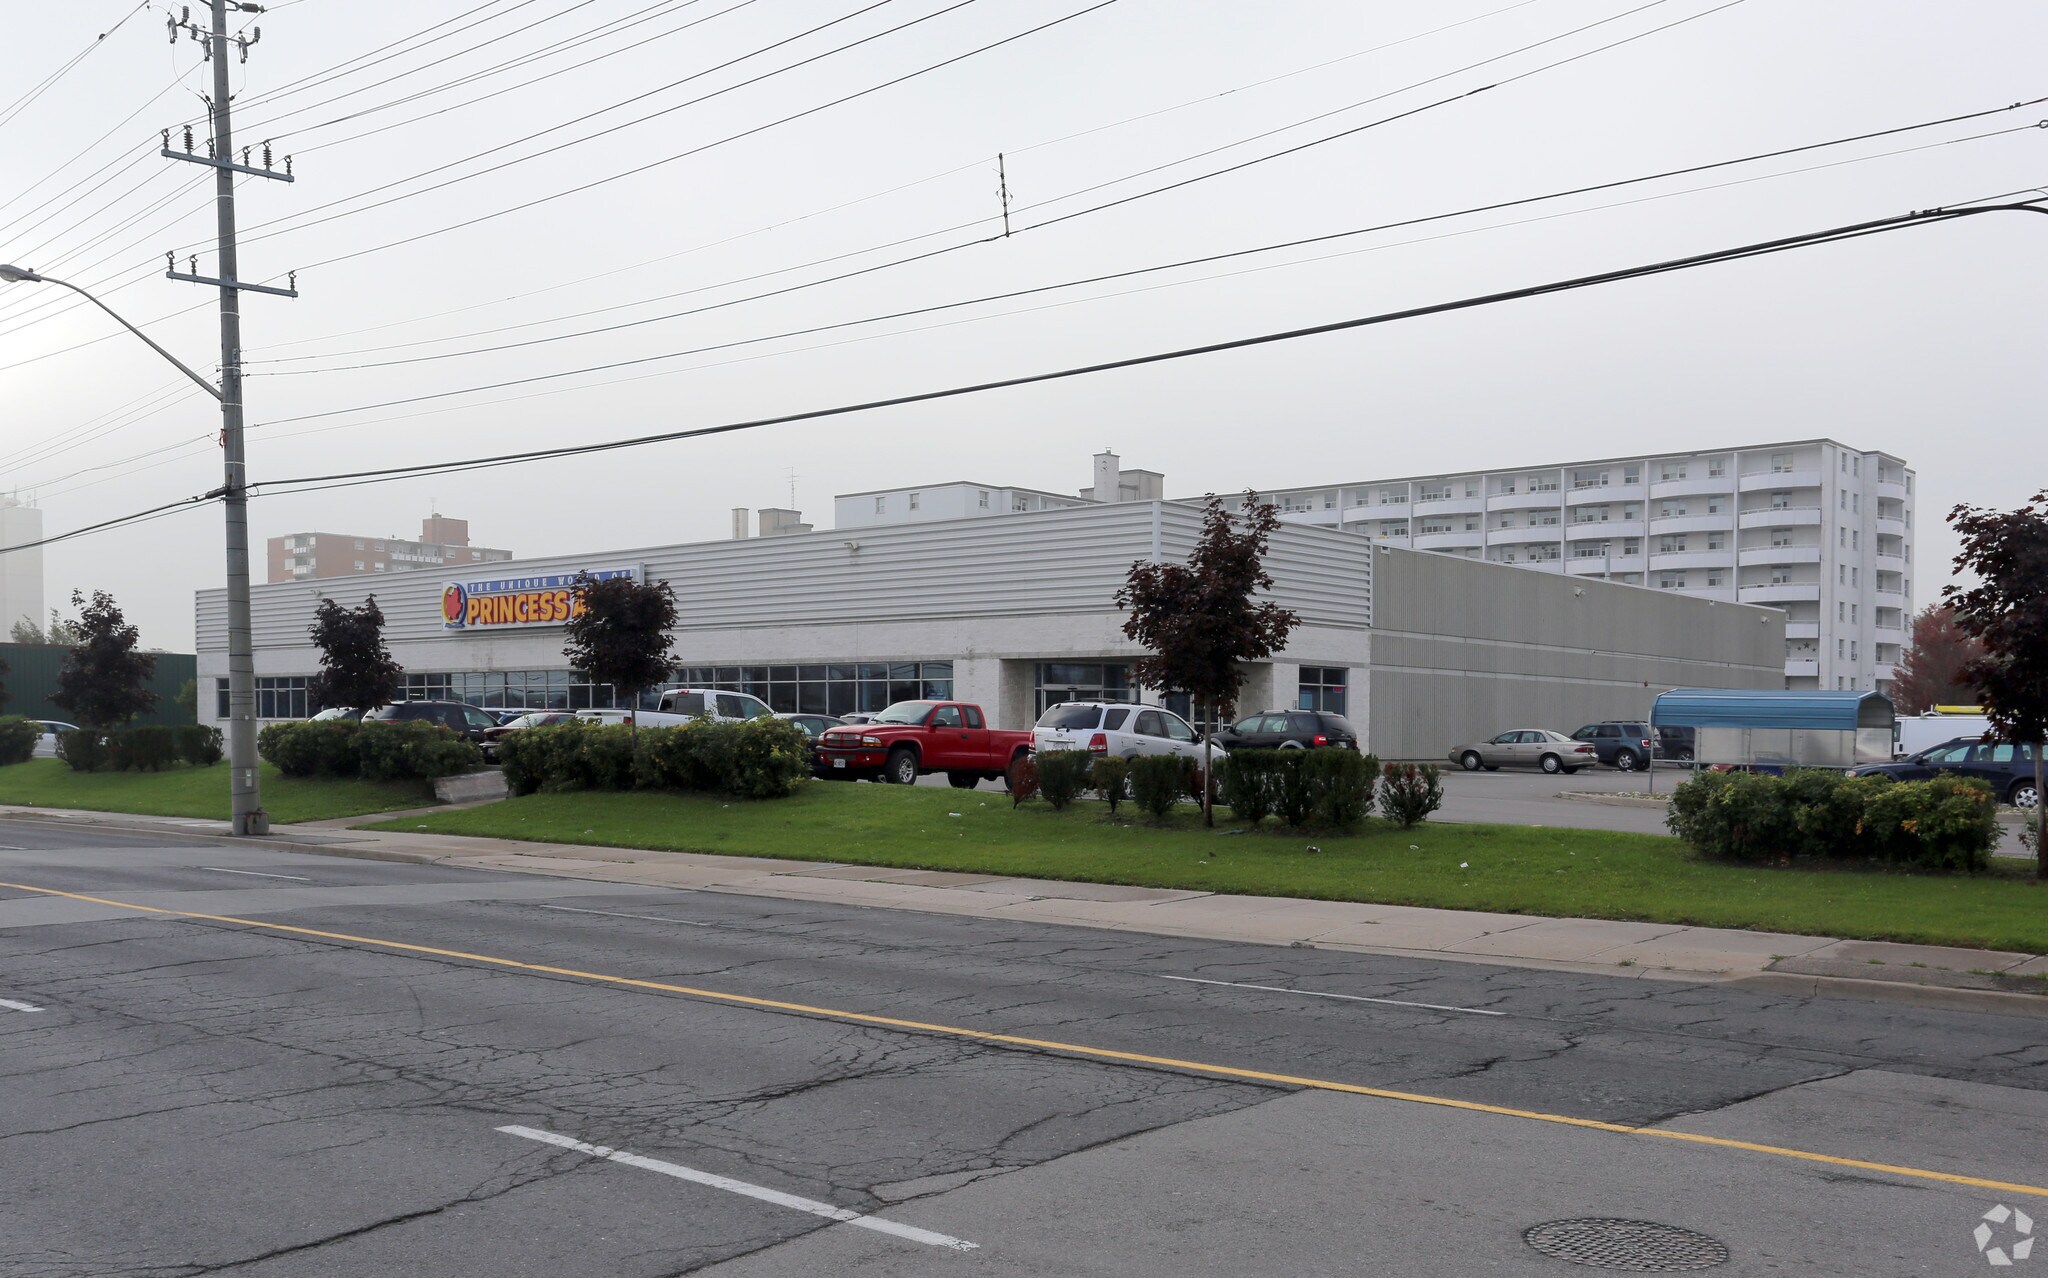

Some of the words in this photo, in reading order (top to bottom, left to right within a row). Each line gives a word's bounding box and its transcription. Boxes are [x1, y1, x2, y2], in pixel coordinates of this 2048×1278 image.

[470, 583, 491, 593] THE
[500, 578, 547, 590] UNIQUE
[467, 590, 571, 625] PRINCESS
